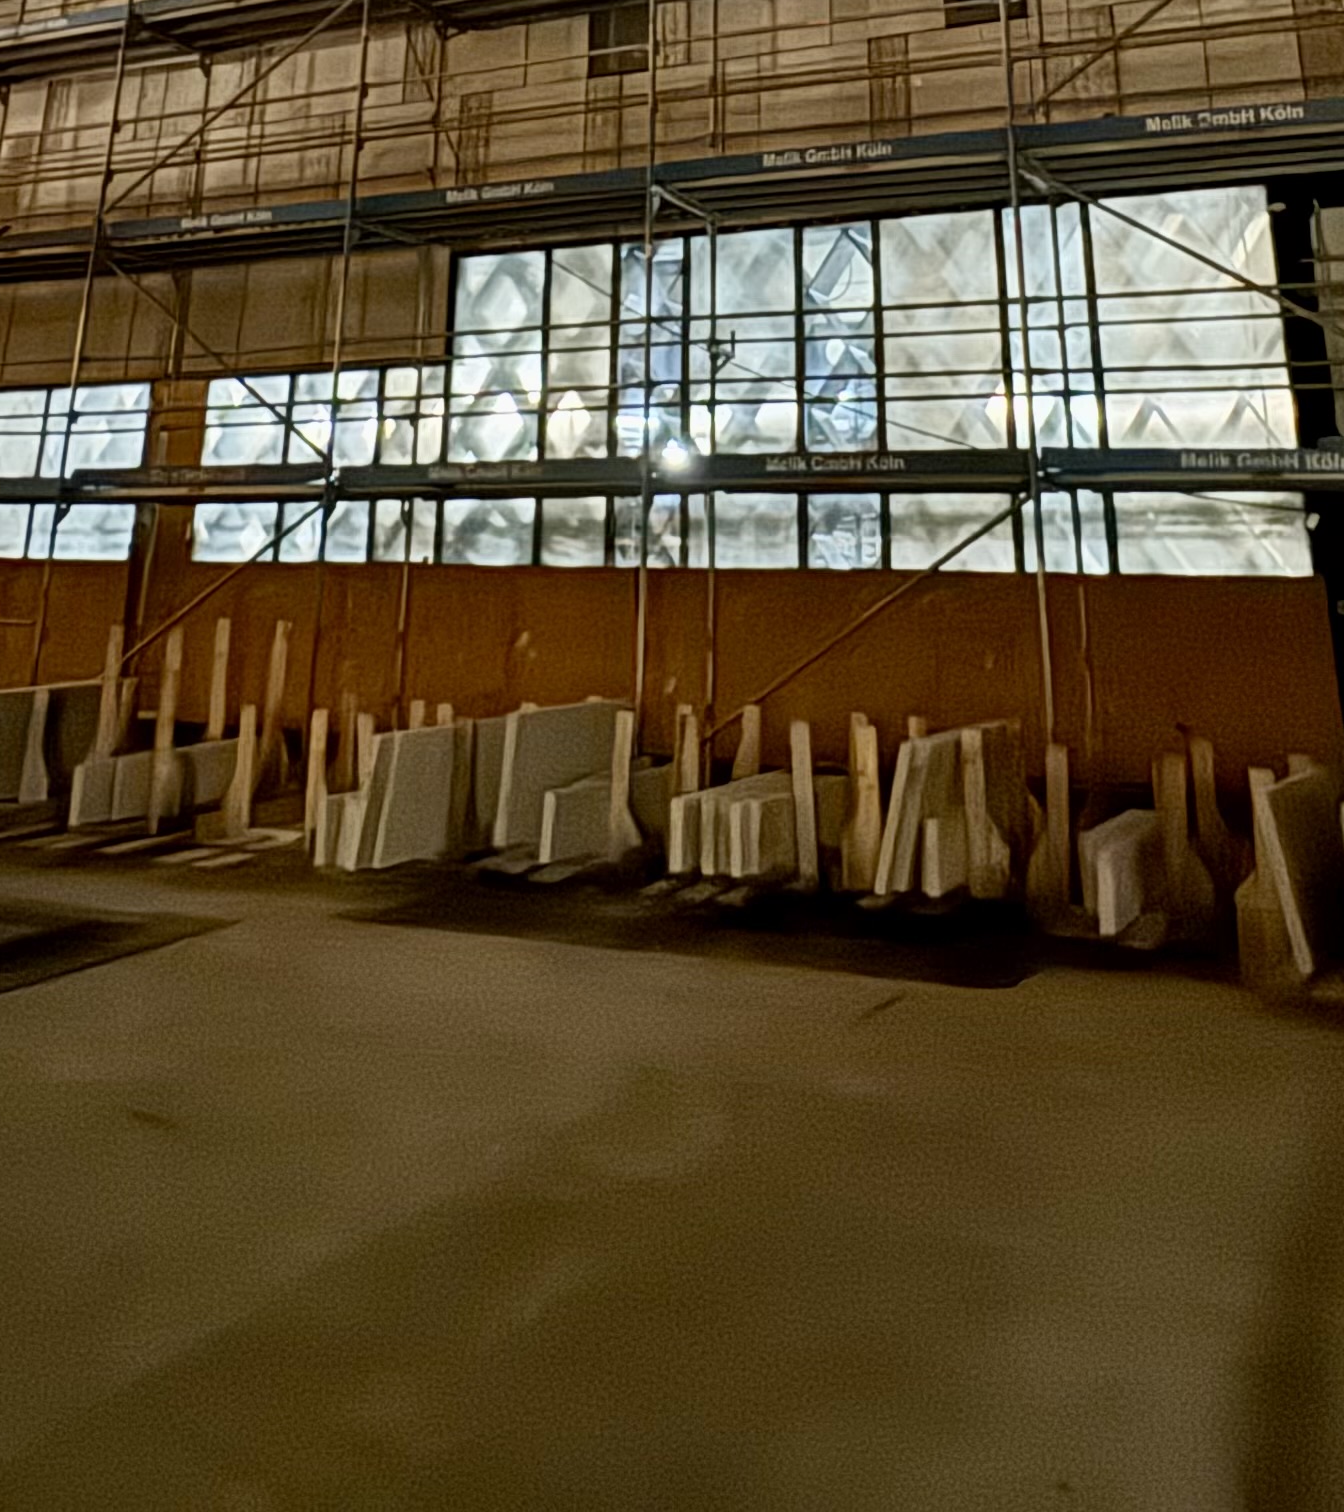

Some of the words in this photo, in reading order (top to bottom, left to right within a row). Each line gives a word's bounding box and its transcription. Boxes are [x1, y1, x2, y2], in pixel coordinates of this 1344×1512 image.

[1145, 114, 1192, 132] Melik
[1197, 108, 1256, 127] GmbH
[1260, 104, 1305, 122] Köln
[805, 146, 853, 164] GmbH
[856, 141, 892, 159] Köln
[866, 454, 906, 470] Köln
